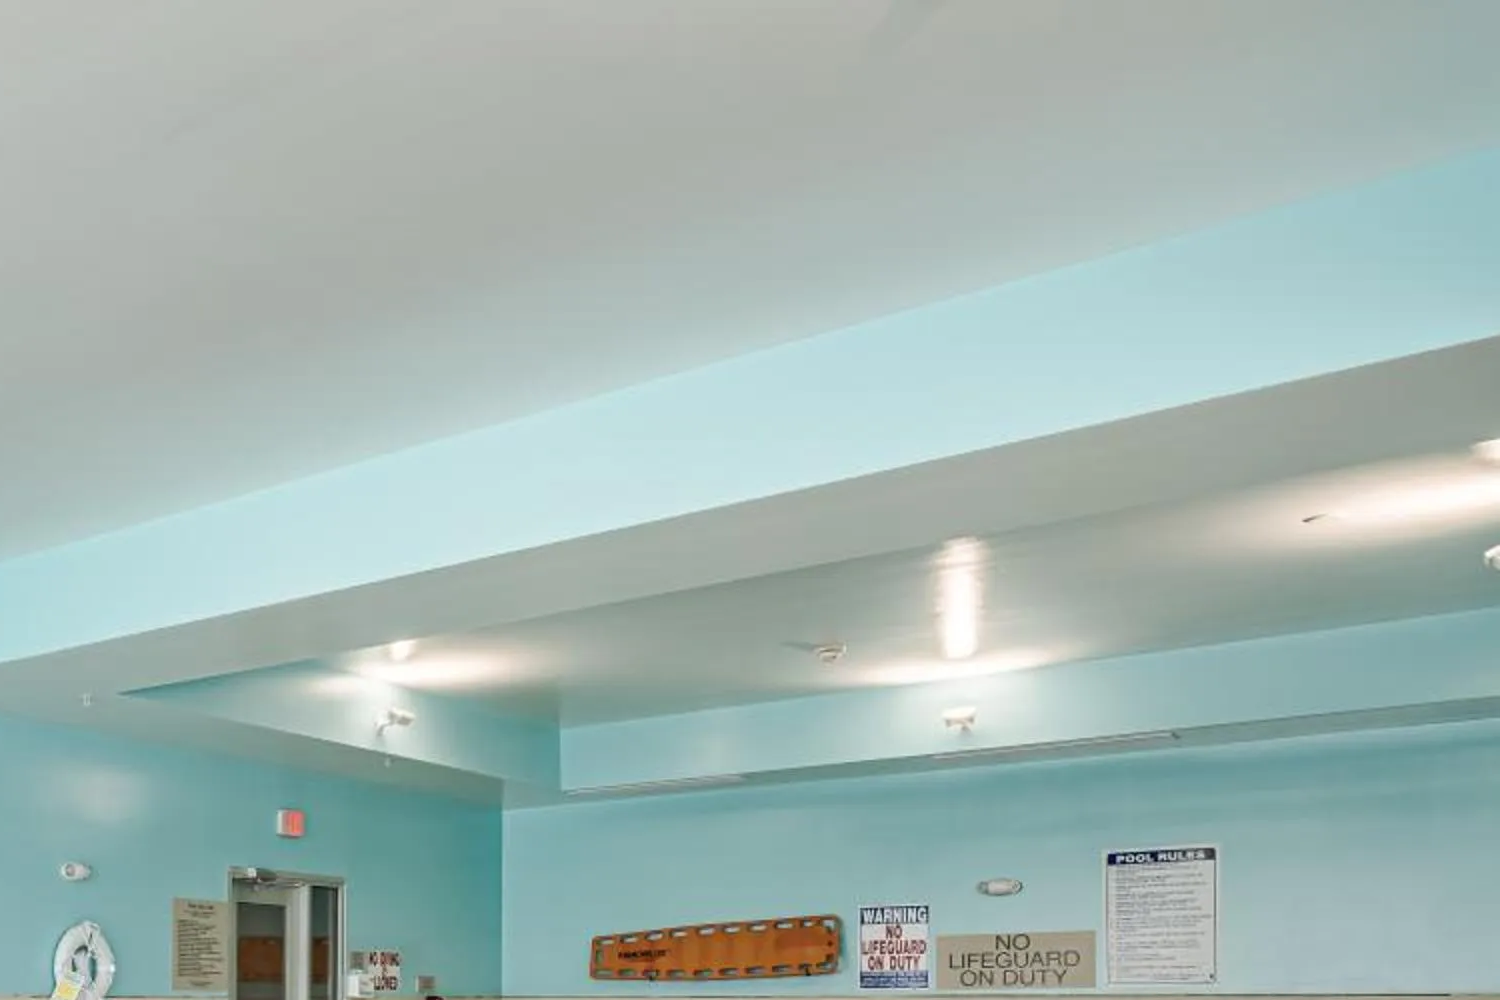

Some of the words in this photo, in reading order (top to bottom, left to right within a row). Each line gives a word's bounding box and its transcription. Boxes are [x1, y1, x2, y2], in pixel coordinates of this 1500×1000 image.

[1116, 853, 1154, 864] POOL
[1158, 850, 1205, 862] RULES
[863, 907, 927, 924] WARNING
[886, 926, 903, 939] NO
[861, 939, 927, 955] LIFEGUARD
[996, 933, 1031, 951] NO
[868, 956, 885, 970] ON
[889, 956, 920, 970] DUTY
[949, 950, 1081, 969] LIFEGUARD
[960, 970, 994, 987] ON
[1003, 969, 1067, 986] DUTY
